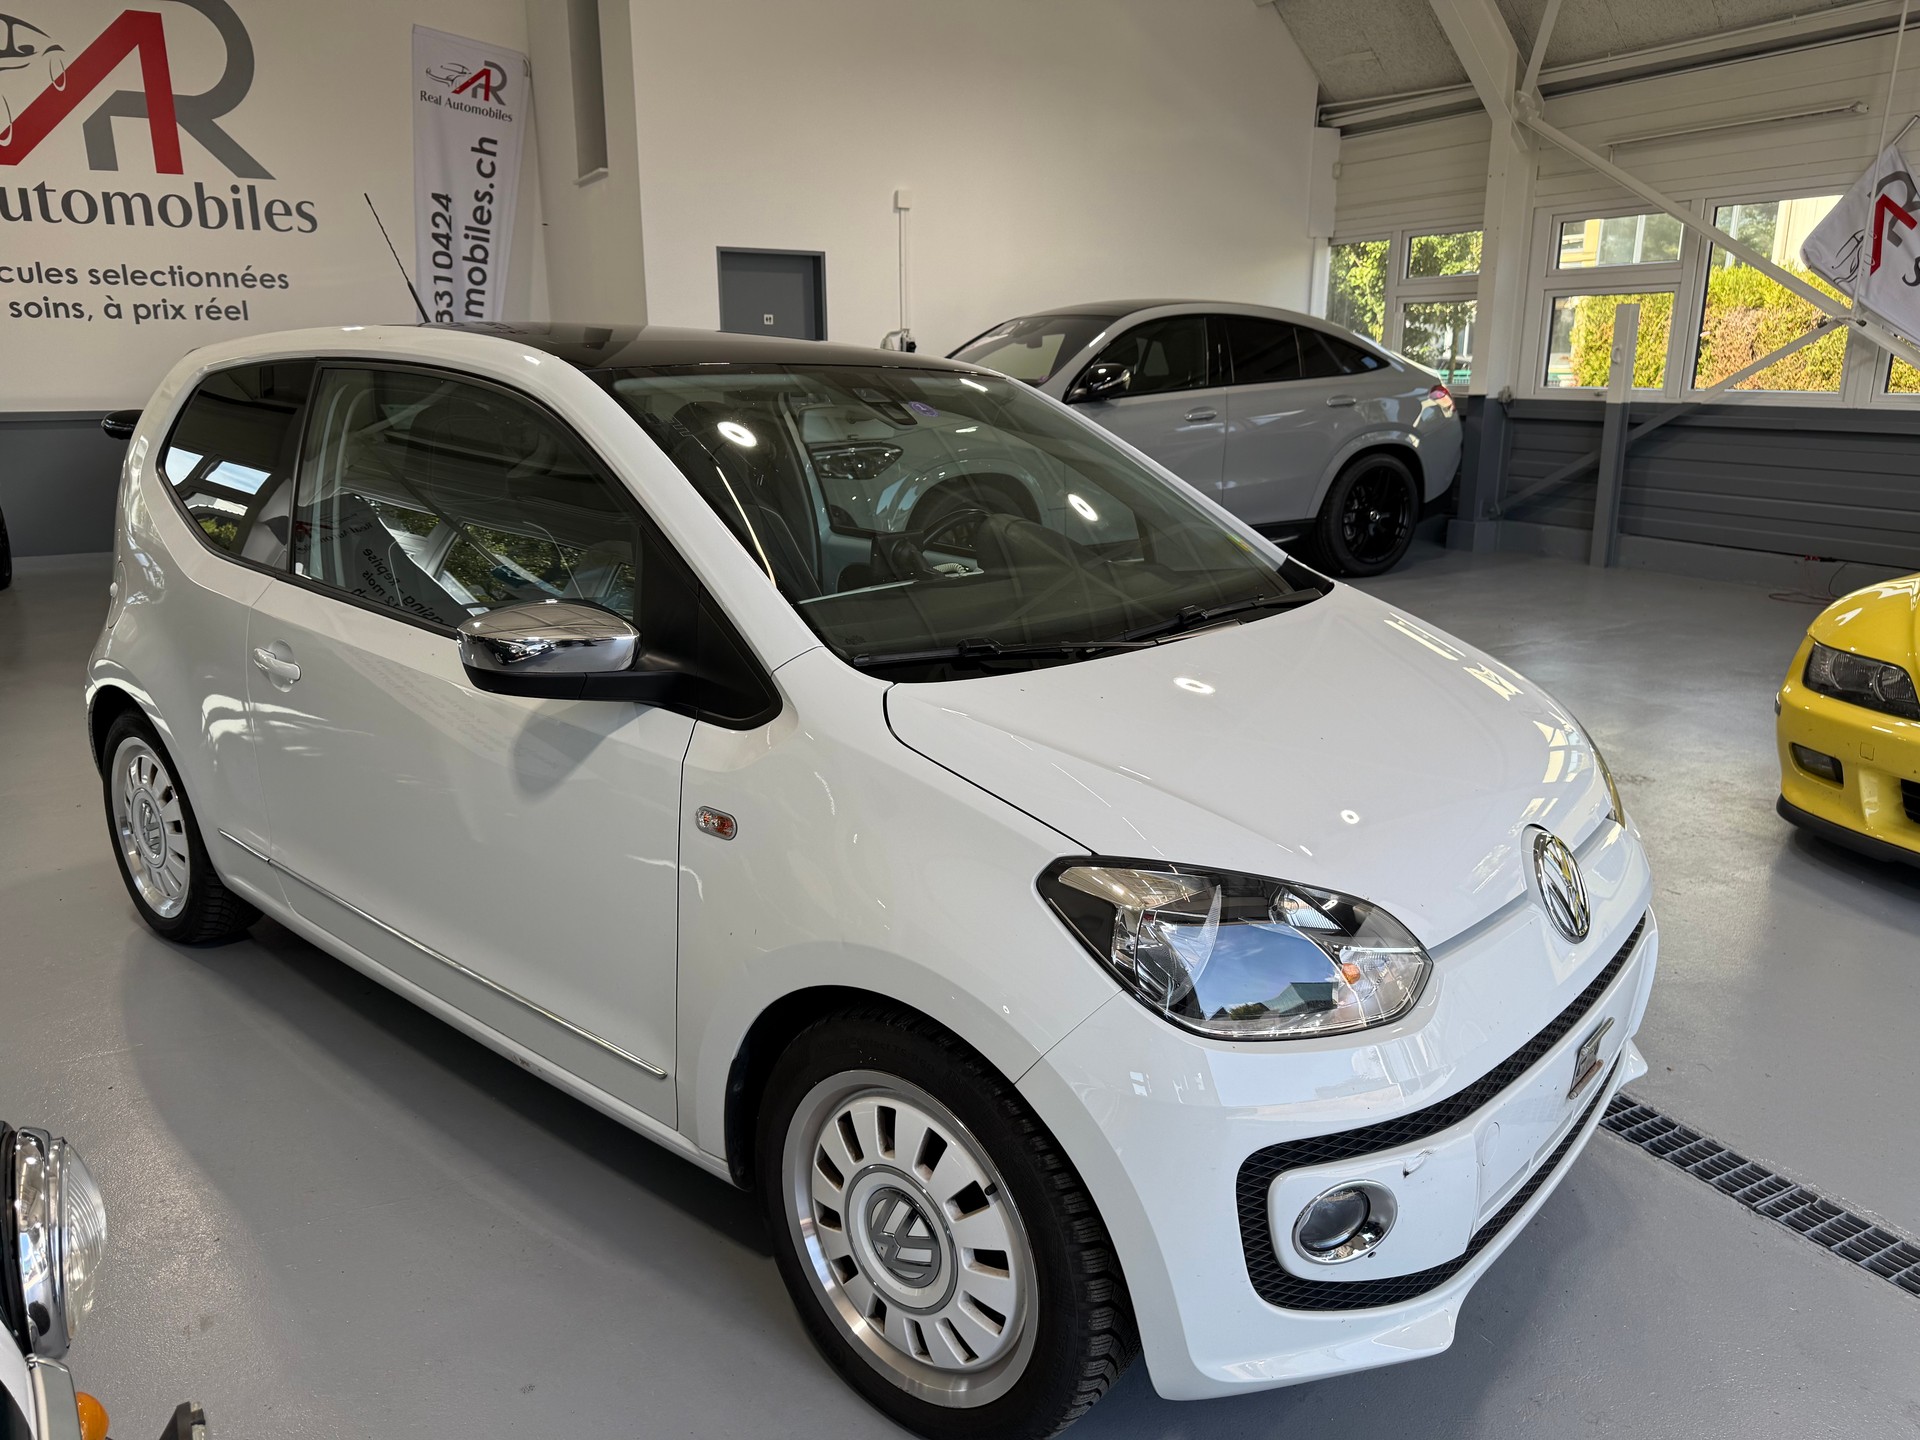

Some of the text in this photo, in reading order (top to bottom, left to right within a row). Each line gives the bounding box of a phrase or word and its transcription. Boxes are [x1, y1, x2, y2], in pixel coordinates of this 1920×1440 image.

[420, 90, 513, 122] Real Automobiles
[0, 181, 318, 233] utomobiles
[462, 136, 498, 318] mobiles.ch
[88, 263, 290, 290] selectionnées
[9, 295, 249, 325] soins, à prix réel
